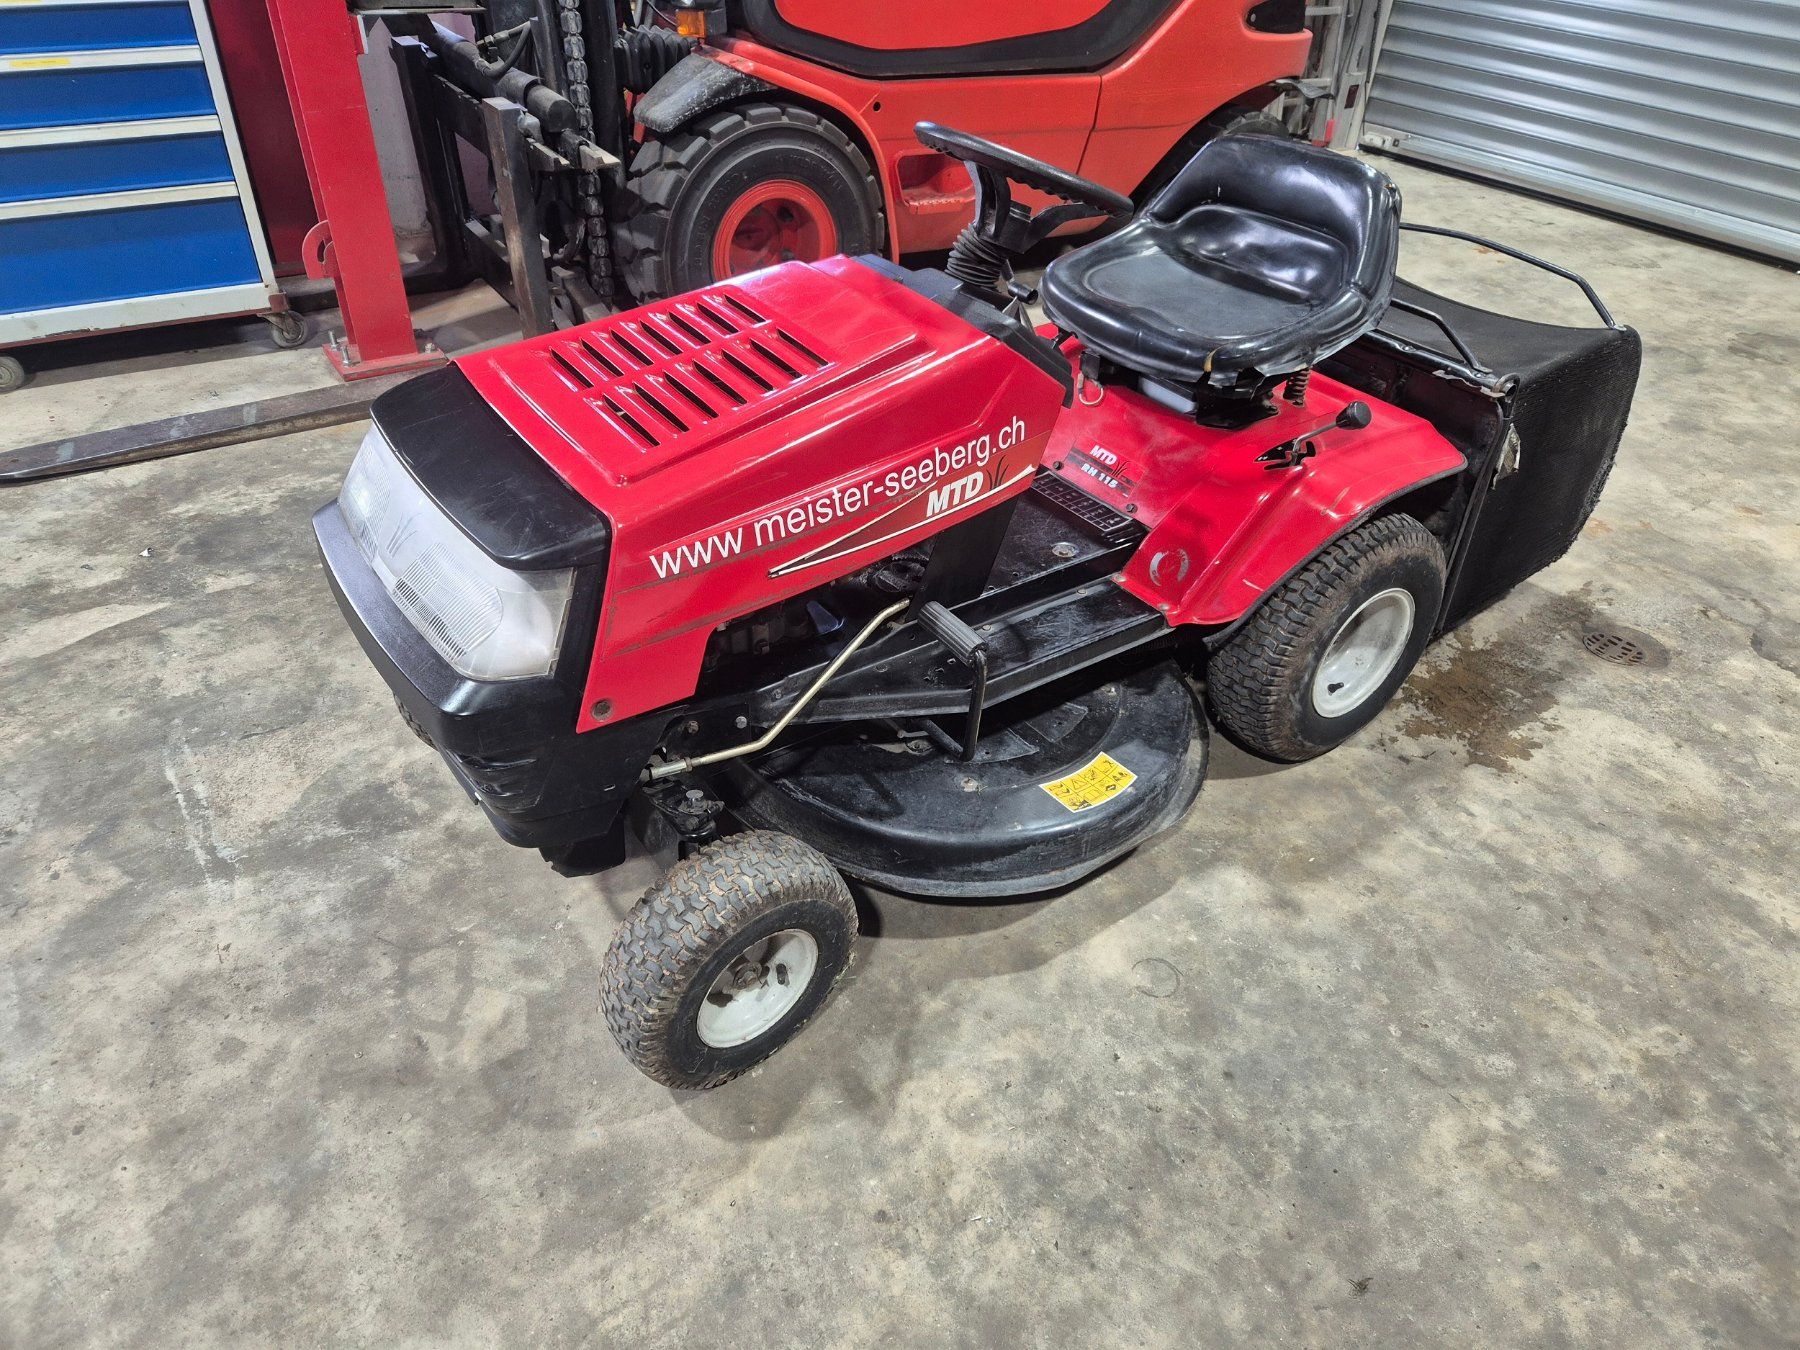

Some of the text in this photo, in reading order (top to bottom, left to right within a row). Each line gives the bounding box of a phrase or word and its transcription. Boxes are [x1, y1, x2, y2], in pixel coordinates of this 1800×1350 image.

[1090, 445, 1117, 465] MTD
[754, 416, 1025, 547] meister-seeberg.ch
[926, 471, 984, 517] MTD
